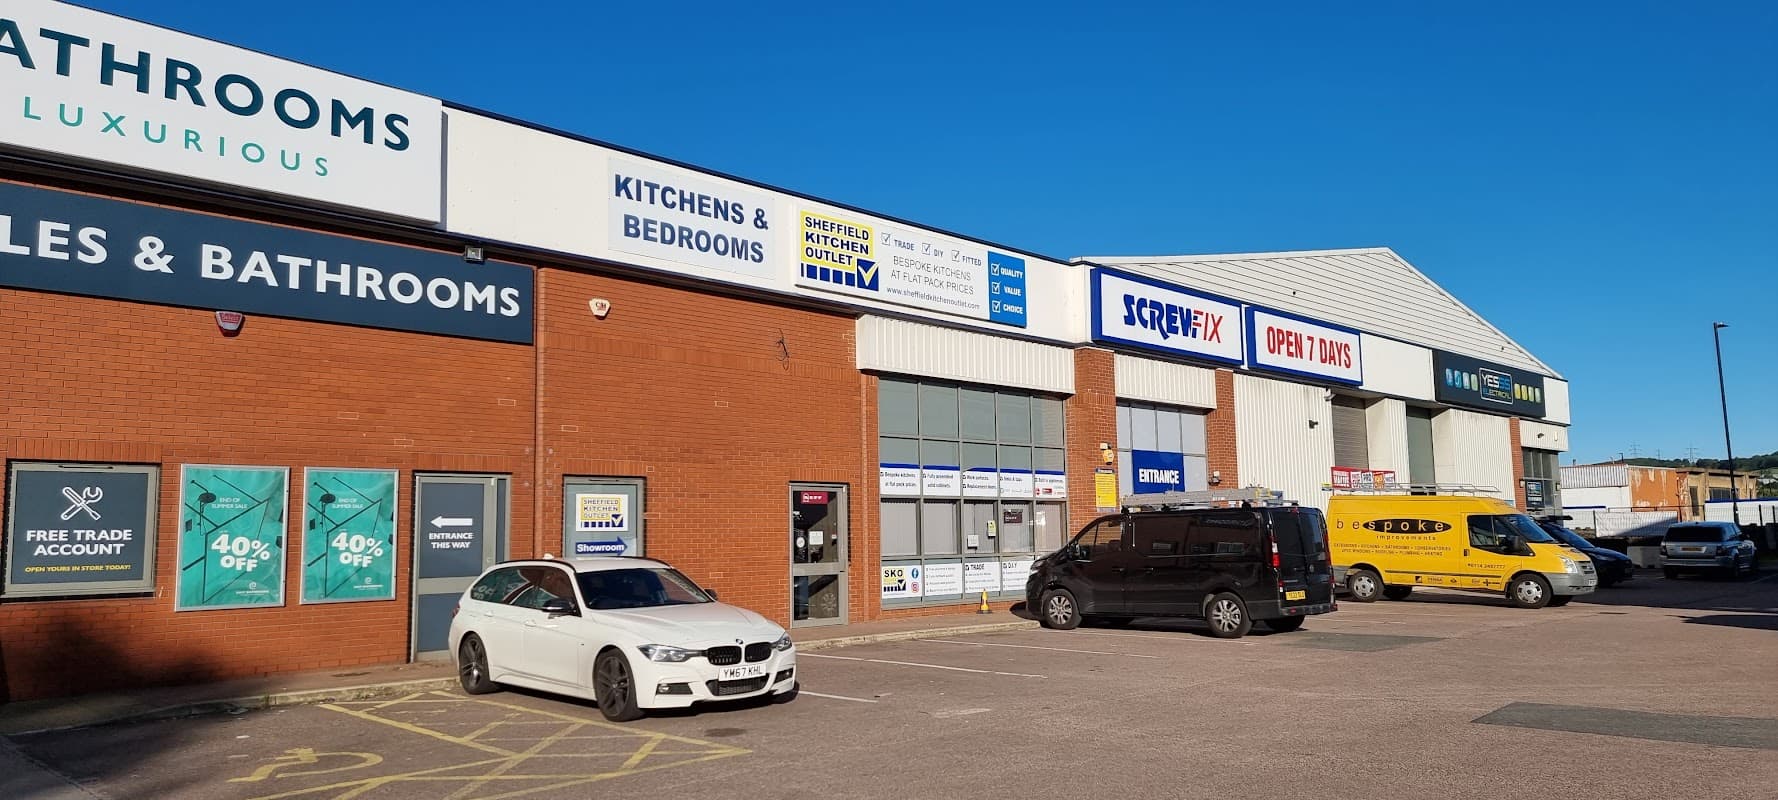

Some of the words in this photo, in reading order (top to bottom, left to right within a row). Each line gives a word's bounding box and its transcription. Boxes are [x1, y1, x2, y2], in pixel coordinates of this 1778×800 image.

[0, 18, 411, 152] ATHROOMS
[23, 96, 330, 177] LUXURIOUS
[614, 173, 745, 225] KITCHENS
[753, 206, 769, 231] &
[623, 213, 764, 264] BEDROOMS
[805, 216, 869, 241] SHEFFIELD
[805, 231, 869, 255] KITCHEN
[894, 239, 915, 252] TRADE
[933, 248, 944, 257] DIY
[962, 255, 982, 267] FITTED
[0, 214, 108, 265] LES
[133, 235, 176, 275] &
[201, 243, 520, 318] BATHROOMS
[805, 246, 853, 266] OUTLET
[893, 255, 931, 272] BESPOKE
[933, 264, 971, 282] KITCHENS
[1000, 267, 1024, 279] QUALITY
[890, 269, 901, 280] AT
[903, 272, 922, 285] FLAT
[924, 276, 945, 289] PACK
[946, 281, 974, 296] PRICES
[1004, 285, 1022, 297] VALUE
[886, 287, 981, 310] www.sheffieldkitchenoutlet.com
[1003, 303, 1024, 315] CHOICE
[1123, 293, 1223, 346] SCREWFIX
[1266, 325, 1302, 360] OPEN
[1306, 336, 1316, 362] 7
[1319, 338, 1352, 369] DAYS
[1138, 468, 1180, 484] ENTRANCE
[26, 529, 69, 542] FREE
[73, 529, 133, 541] TRADE
[428, 532, 474, 540] ENTRANCE
[1336, 518, 1444, 534] bespoke
[33, 543, 125, 556] ACCOUNT
[211, 533, 270, 560] 40%
[331, 531, 383, 557] 40%
[431, 541, 450, 549] THIS
[452, 541, 471, 549] WAY
[576, 543, 625, 553] Showroom
[220, 555, 258, 572] OFF
[339, 552, 373, 568] OFF
[884, 569, 904, 578] SKO
[748, 665, 763, 675] KHL
